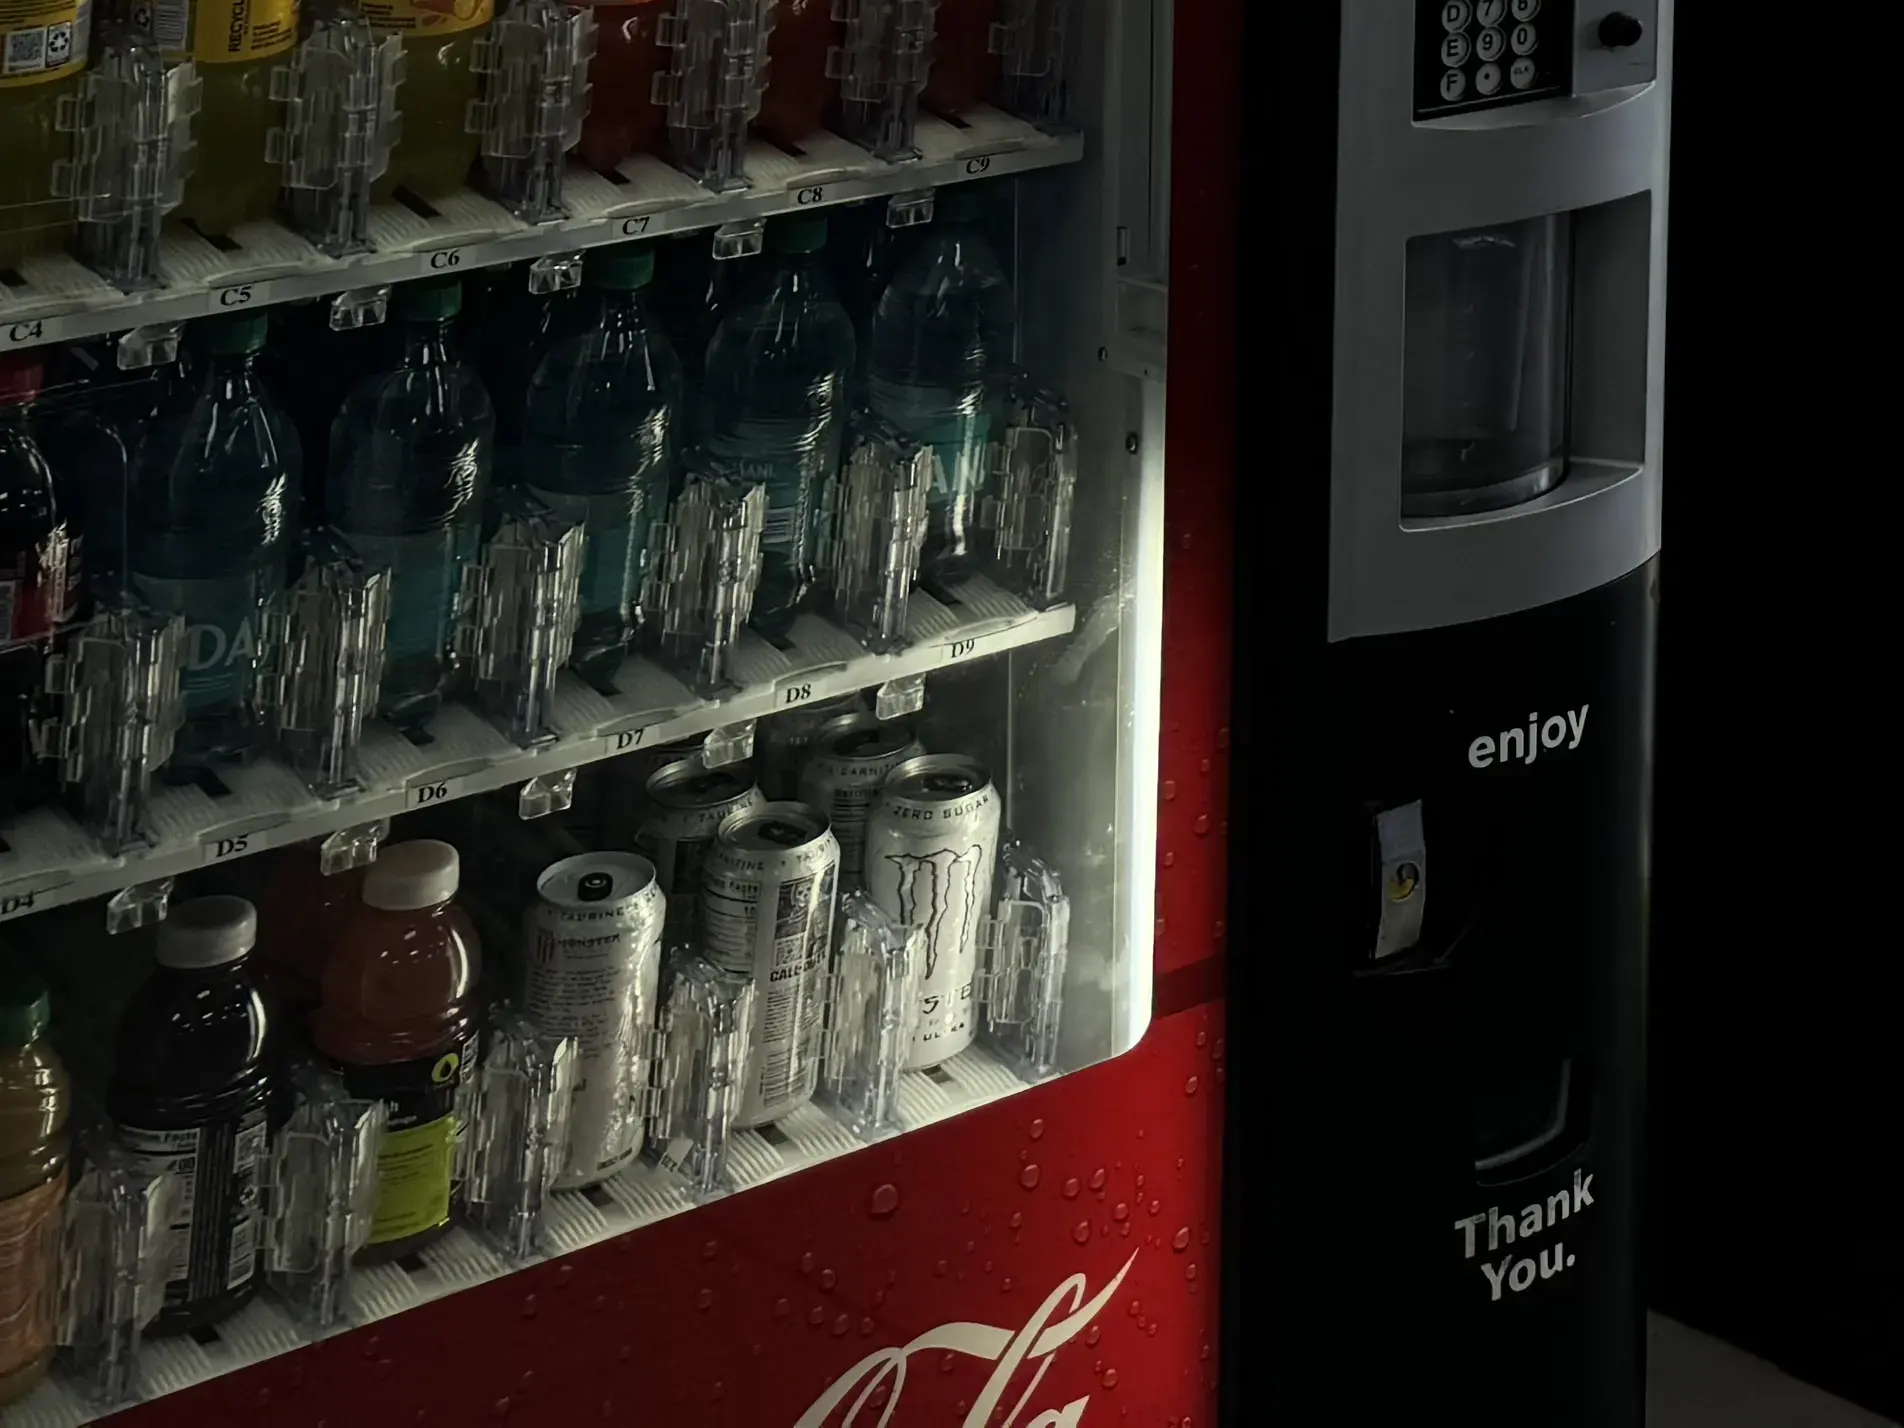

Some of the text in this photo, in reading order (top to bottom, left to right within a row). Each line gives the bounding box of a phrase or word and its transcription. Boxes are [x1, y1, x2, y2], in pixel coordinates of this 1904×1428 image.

[9, 157, 991, 341] C4 C5 C6 C7 C8 C9
[215, 836, 249, 858] D5
[417, 782, 448, 802] D6
[617, 729, 645, 748] D7
[785, 684, 812, 703] D8
[950, 639, 976, 659] D9
[1467, 704, 1589, 768] enjoy
[893, 794, 990, 821] ZERO SUGAR
[1454, 1168, 1595, 1258] Thank
[1479, 1243, 1576, 1301] You.
